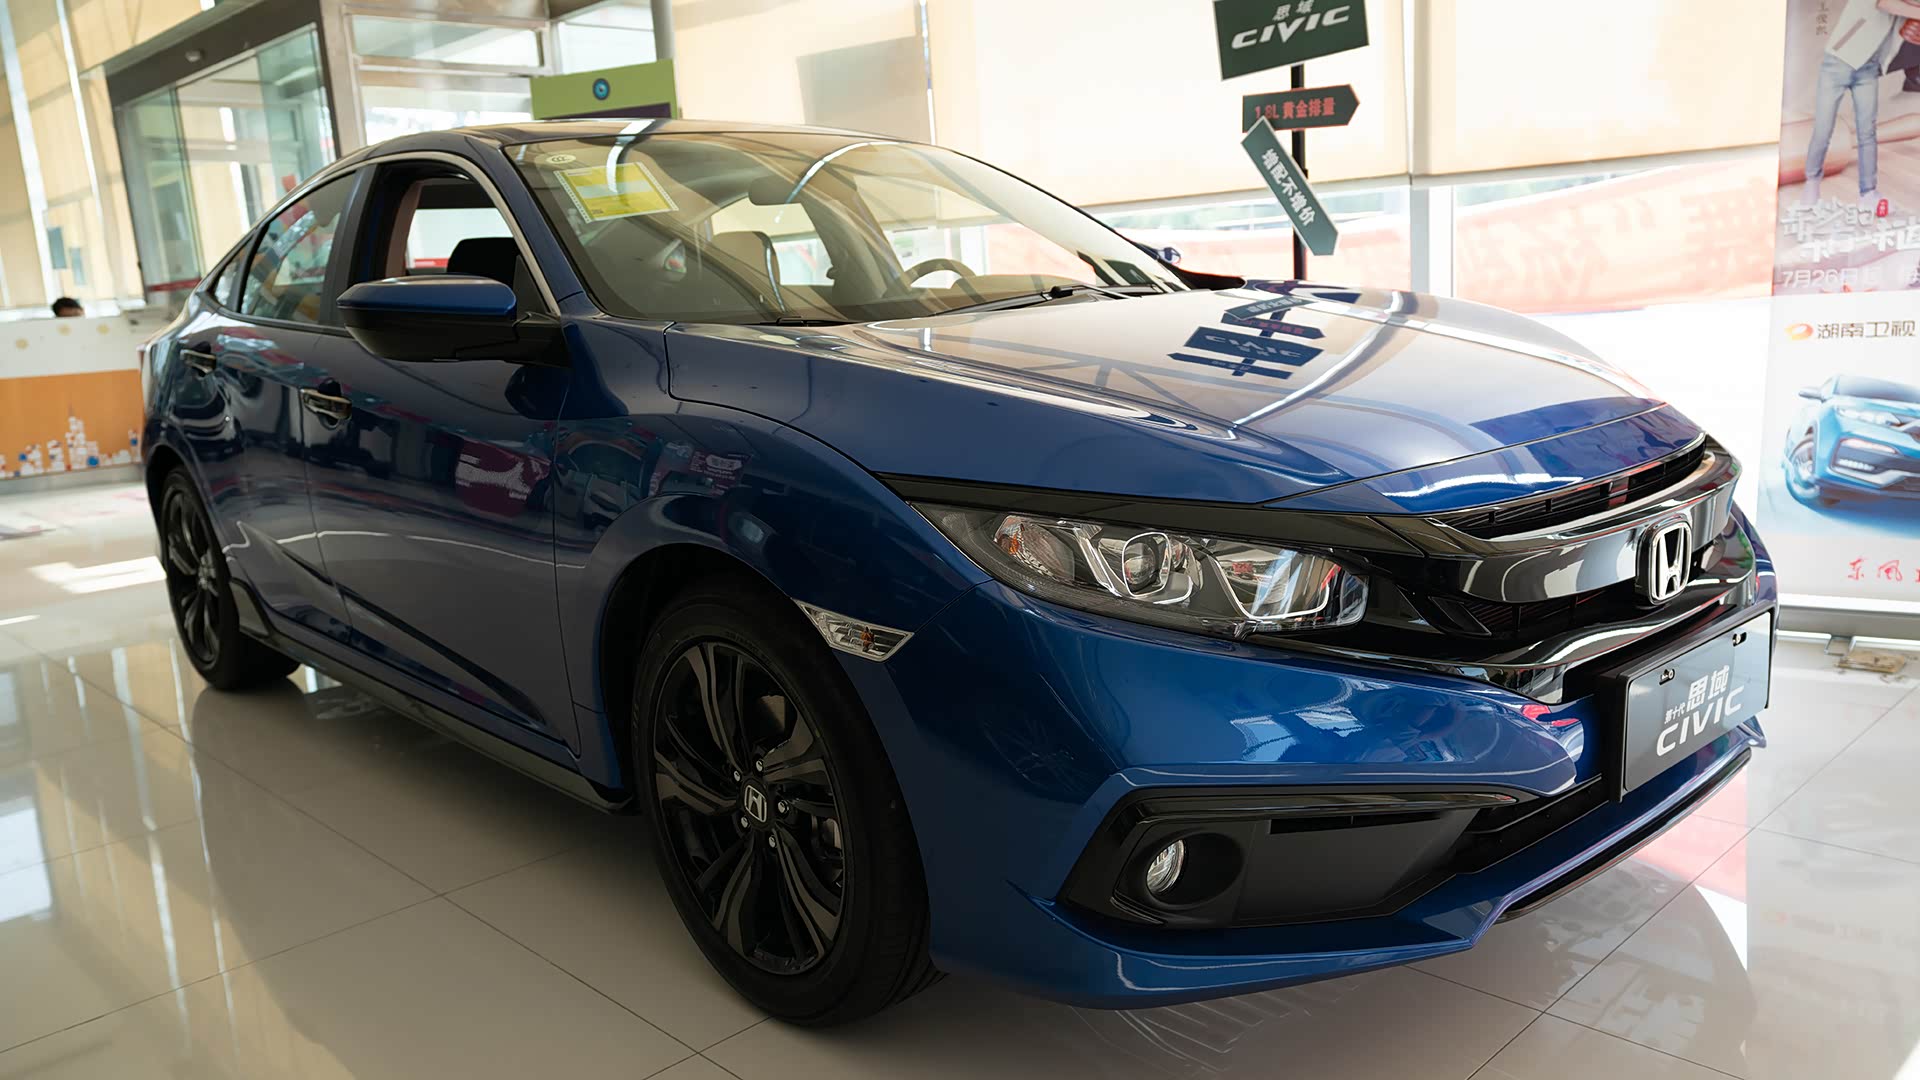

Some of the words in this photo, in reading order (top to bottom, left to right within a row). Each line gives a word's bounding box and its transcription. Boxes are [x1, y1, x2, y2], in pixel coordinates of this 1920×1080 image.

[1231, 5, 1351, 49] CIVIC
[1255, 104, 1280, 119] 18L
[1262, 148, 1316, 226] 增配不增价
[1817, 320, 1916, 339] 湖南卫视
[1686, 664, 1730, 713] 思域
[1656, 685, 1745, 757] CIVIC
